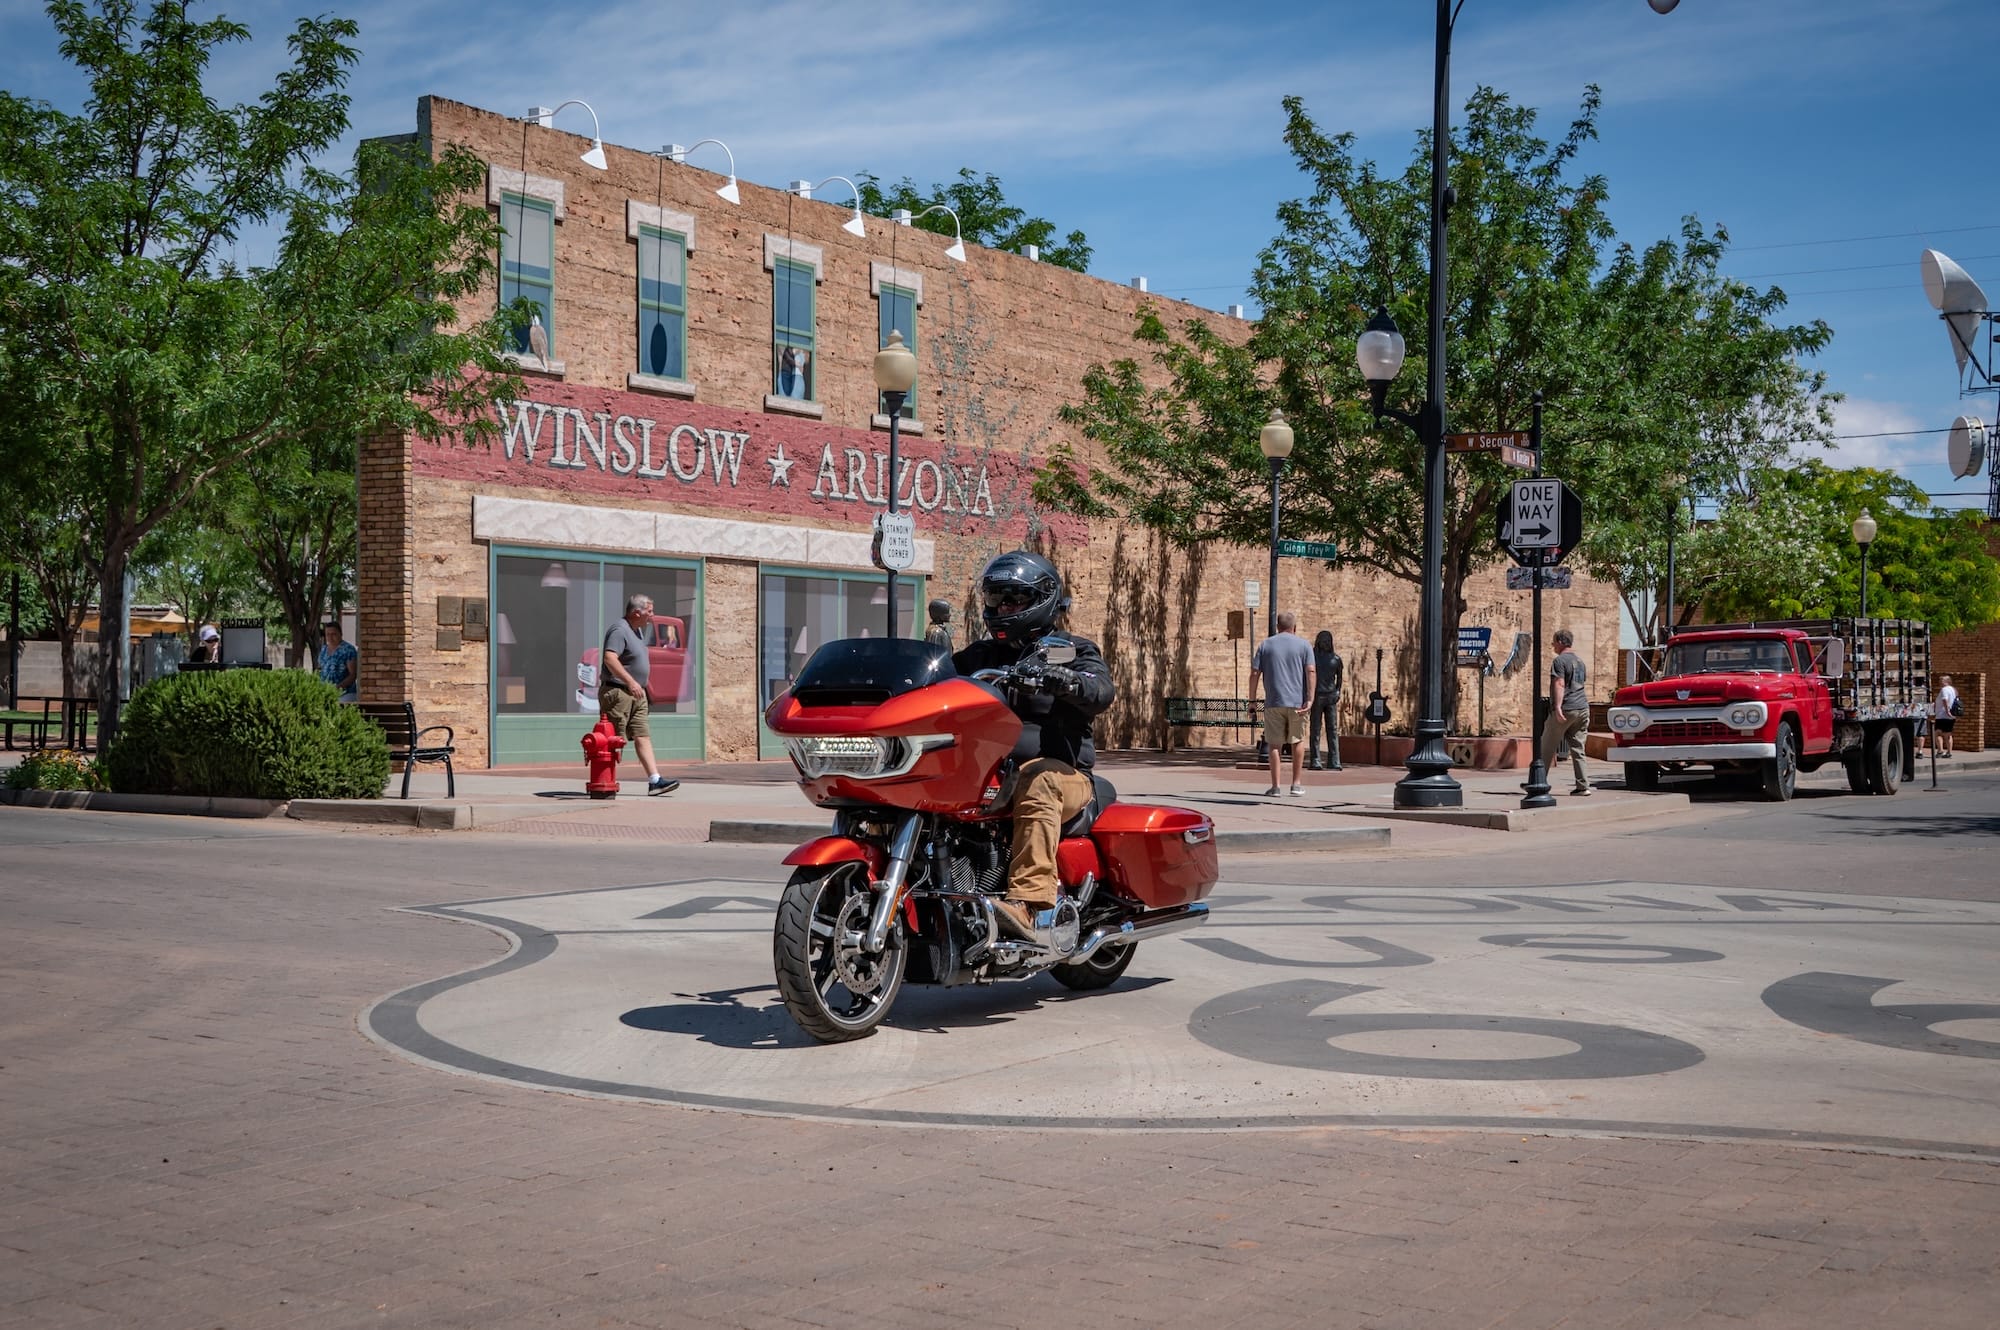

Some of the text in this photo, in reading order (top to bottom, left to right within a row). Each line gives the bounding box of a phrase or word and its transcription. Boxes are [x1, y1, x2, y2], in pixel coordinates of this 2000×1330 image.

[1467, 437, 1474, 447] W
[1480, 433, 1515, 449] Second
[495, 398, 995, 516] WINSLOW ARIZONA
[1519, 486, 1554, 501] ONE
[1518, 504, 1554, 520] WAY
[887, 524, 910, 534] STANDIN'
[889, 537, 908, 547] ON THE
[888, 549, 908, 558] CORNER
[1284, 543, 1306, 553] Glenn
[1307, 544, 1324, 557] Frey
[1458, 640, 1486, 648] TRACTION
